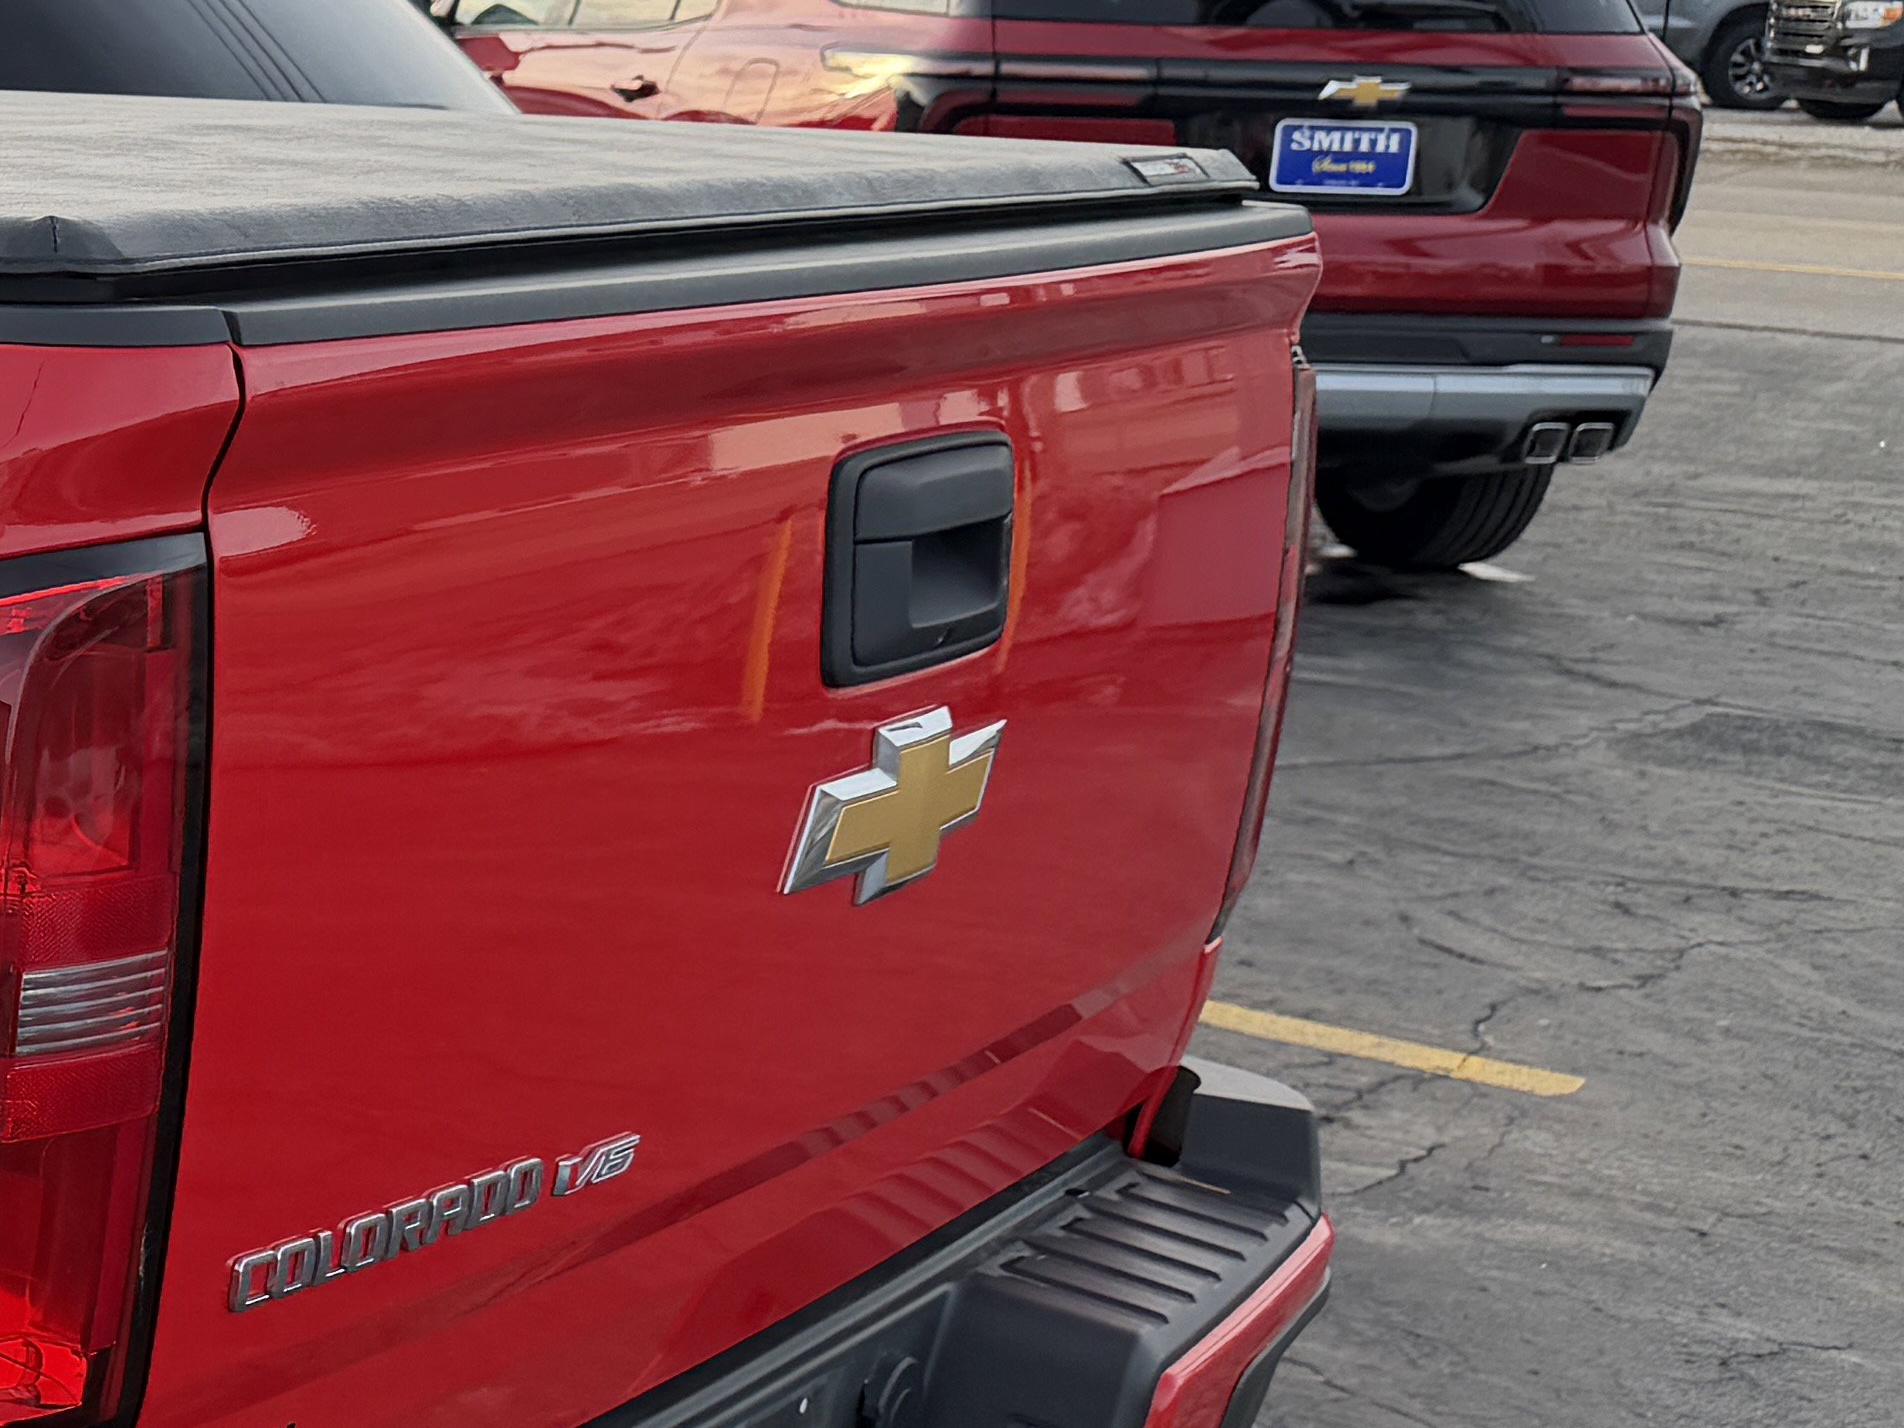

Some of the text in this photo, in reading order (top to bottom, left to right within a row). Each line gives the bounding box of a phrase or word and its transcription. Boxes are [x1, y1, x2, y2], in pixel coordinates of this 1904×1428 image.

[1290, 128, 1400, 153] SMITH
[228, 1131, 641, 1312] COLORADO V6
